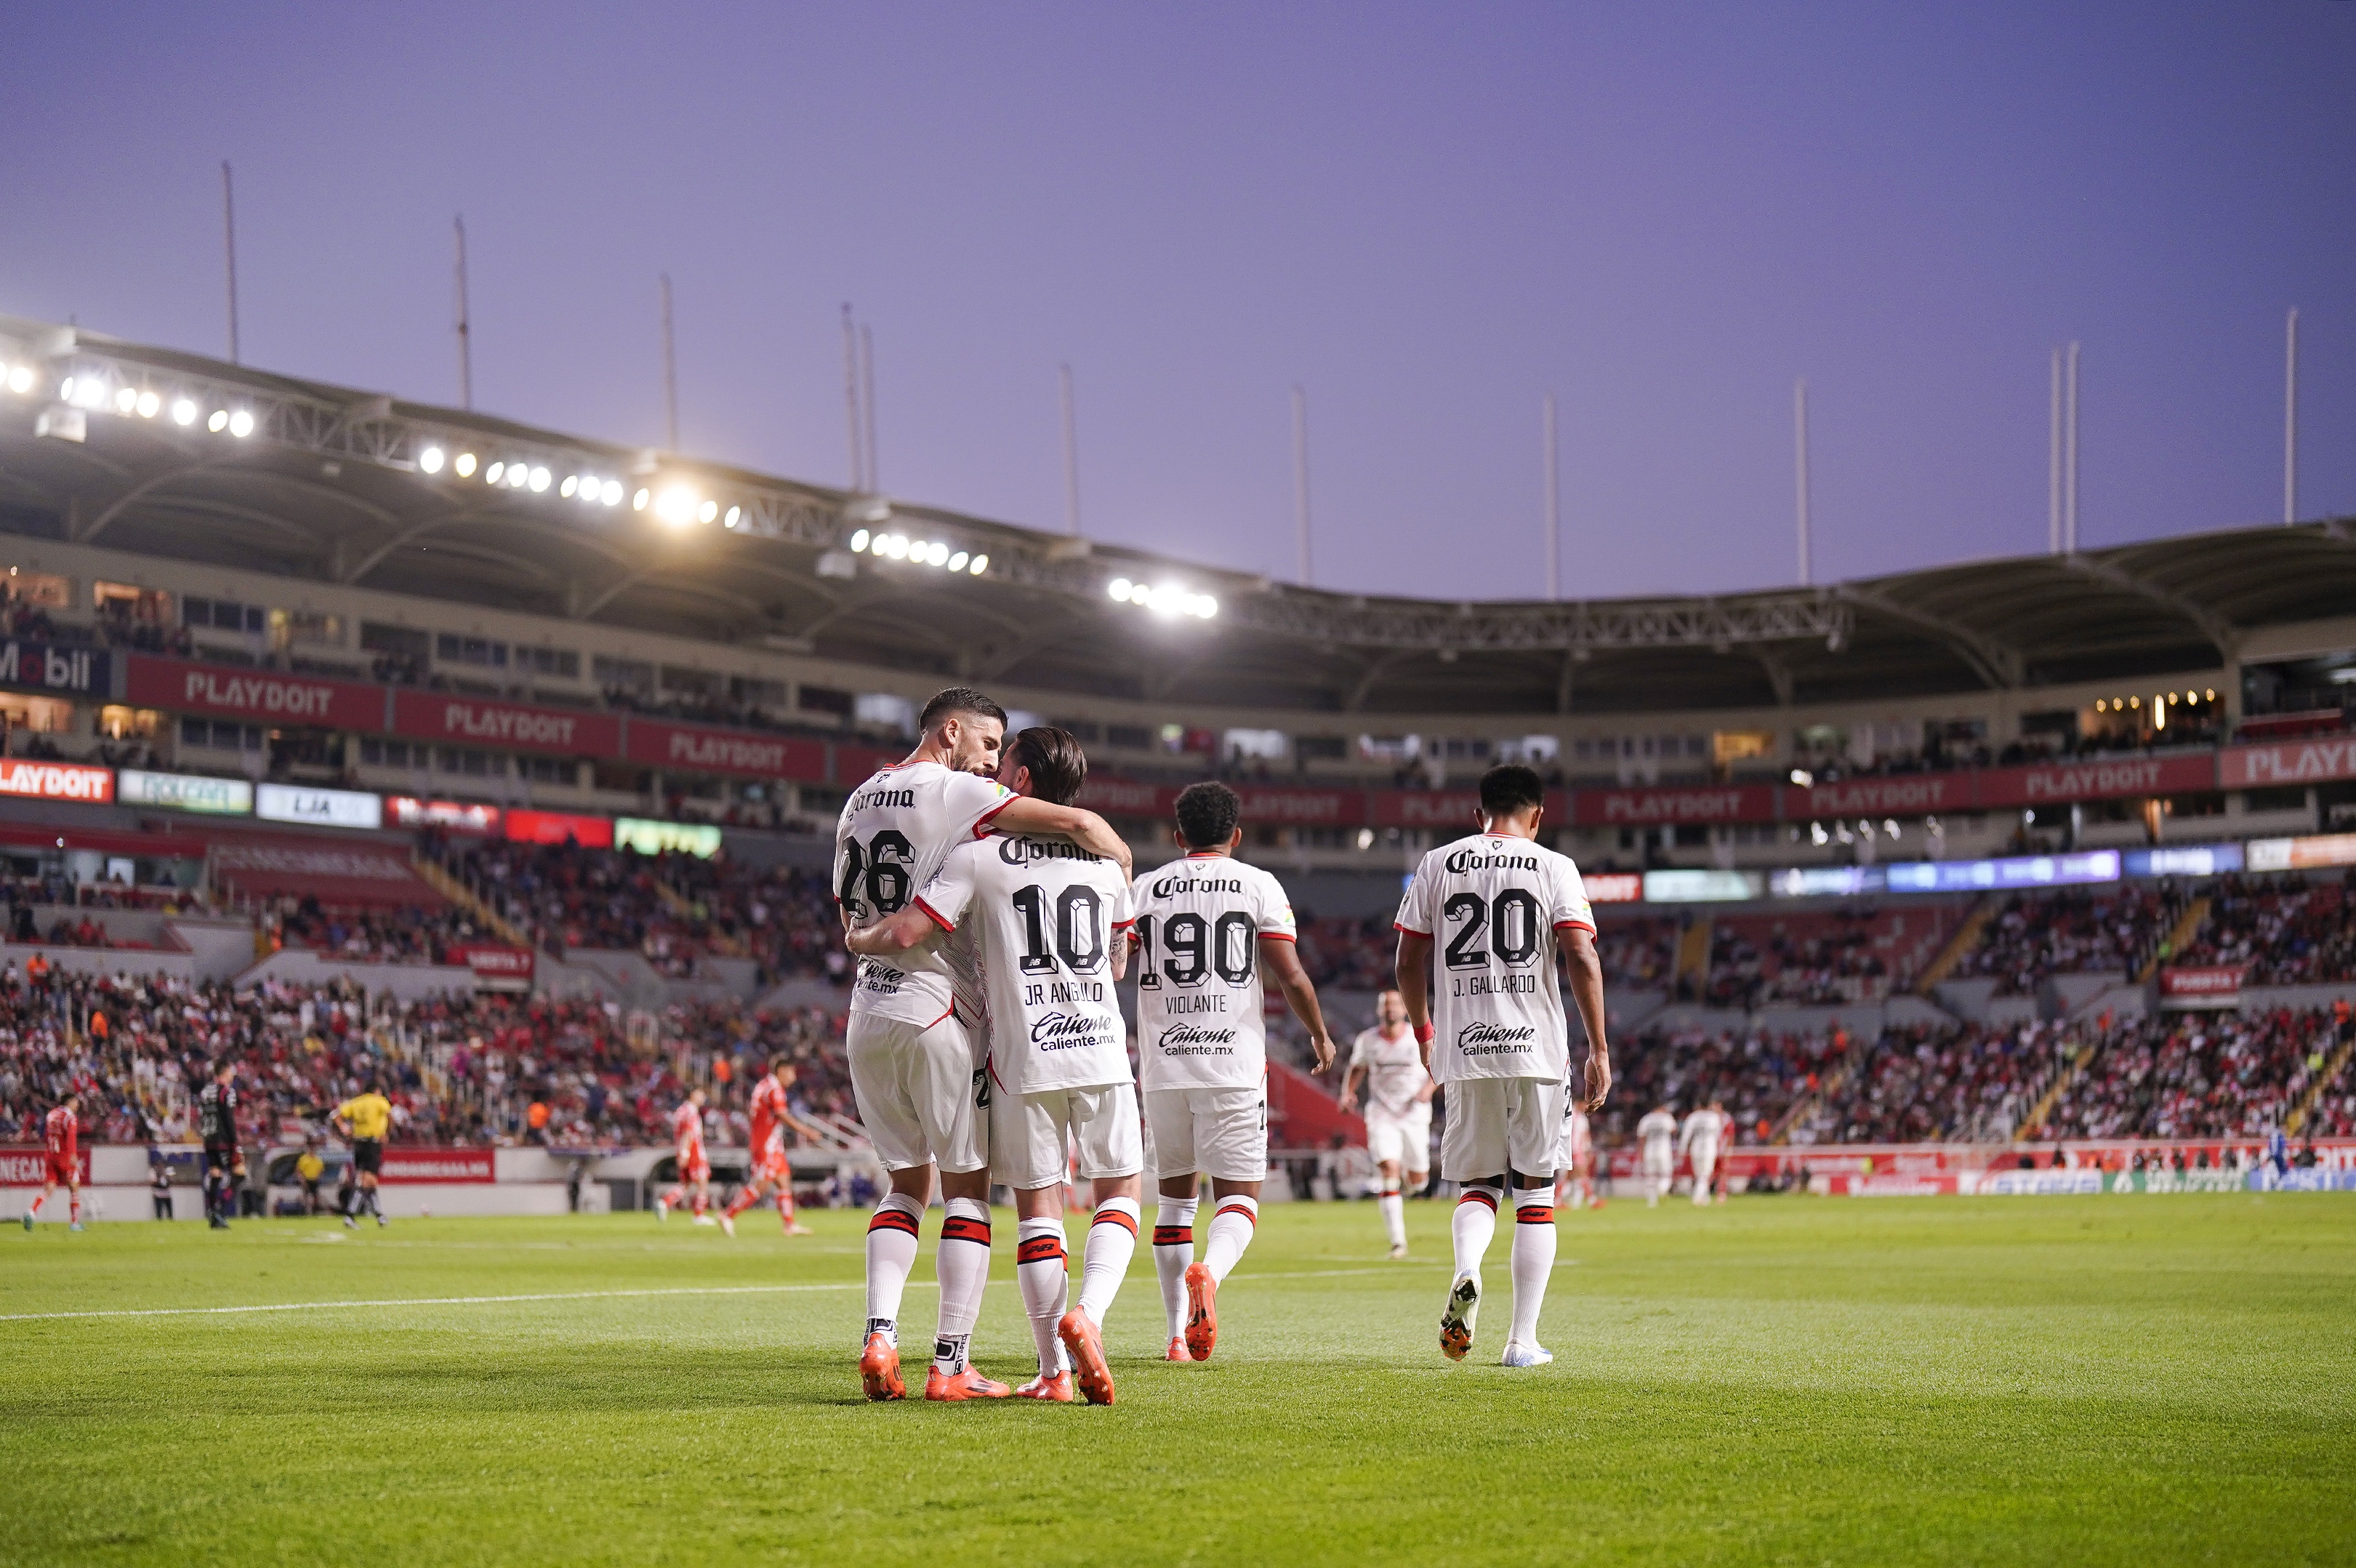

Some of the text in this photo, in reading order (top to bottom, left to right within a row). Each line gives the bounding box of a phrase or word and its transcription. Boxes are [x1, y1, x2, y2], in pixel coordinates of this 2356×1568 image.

[185, 671, 334, 717] PLAYDOIT
[446, 704, 576, 746] PLAYDOIT
[0, 763, 108, 799] LAYDOIT
[2027, 762, 2162, 797] PLAYDOIT
[840, 830, 916, 919] 26
[1446, 848, 1537, 877] Corona
[1152, 875, 1242, 901] Corona
[1013, 885, 1108, 976] 10
[1444, 888, 1543, 971] 20
[1136, 911, 1258, 990] 190
[1025, 983, 1045, 1006] JR
[1454, 974, 1535, 997] J. GALLARDO
[1165, 994, 1227, 1015] VIOLANTE
[1029, 1010, 1112, 1043] Caliente
[1159, 1021, 1236, 1048] Caliente
[1458, 1021, 1535, 1049] Caliente
[1040, 1034, 1116, 1052] caliente.mx
[1165, 1044, 1234, 1056] caliente.mx
[1463, 1042, 1533, 1056] caliente.mx
